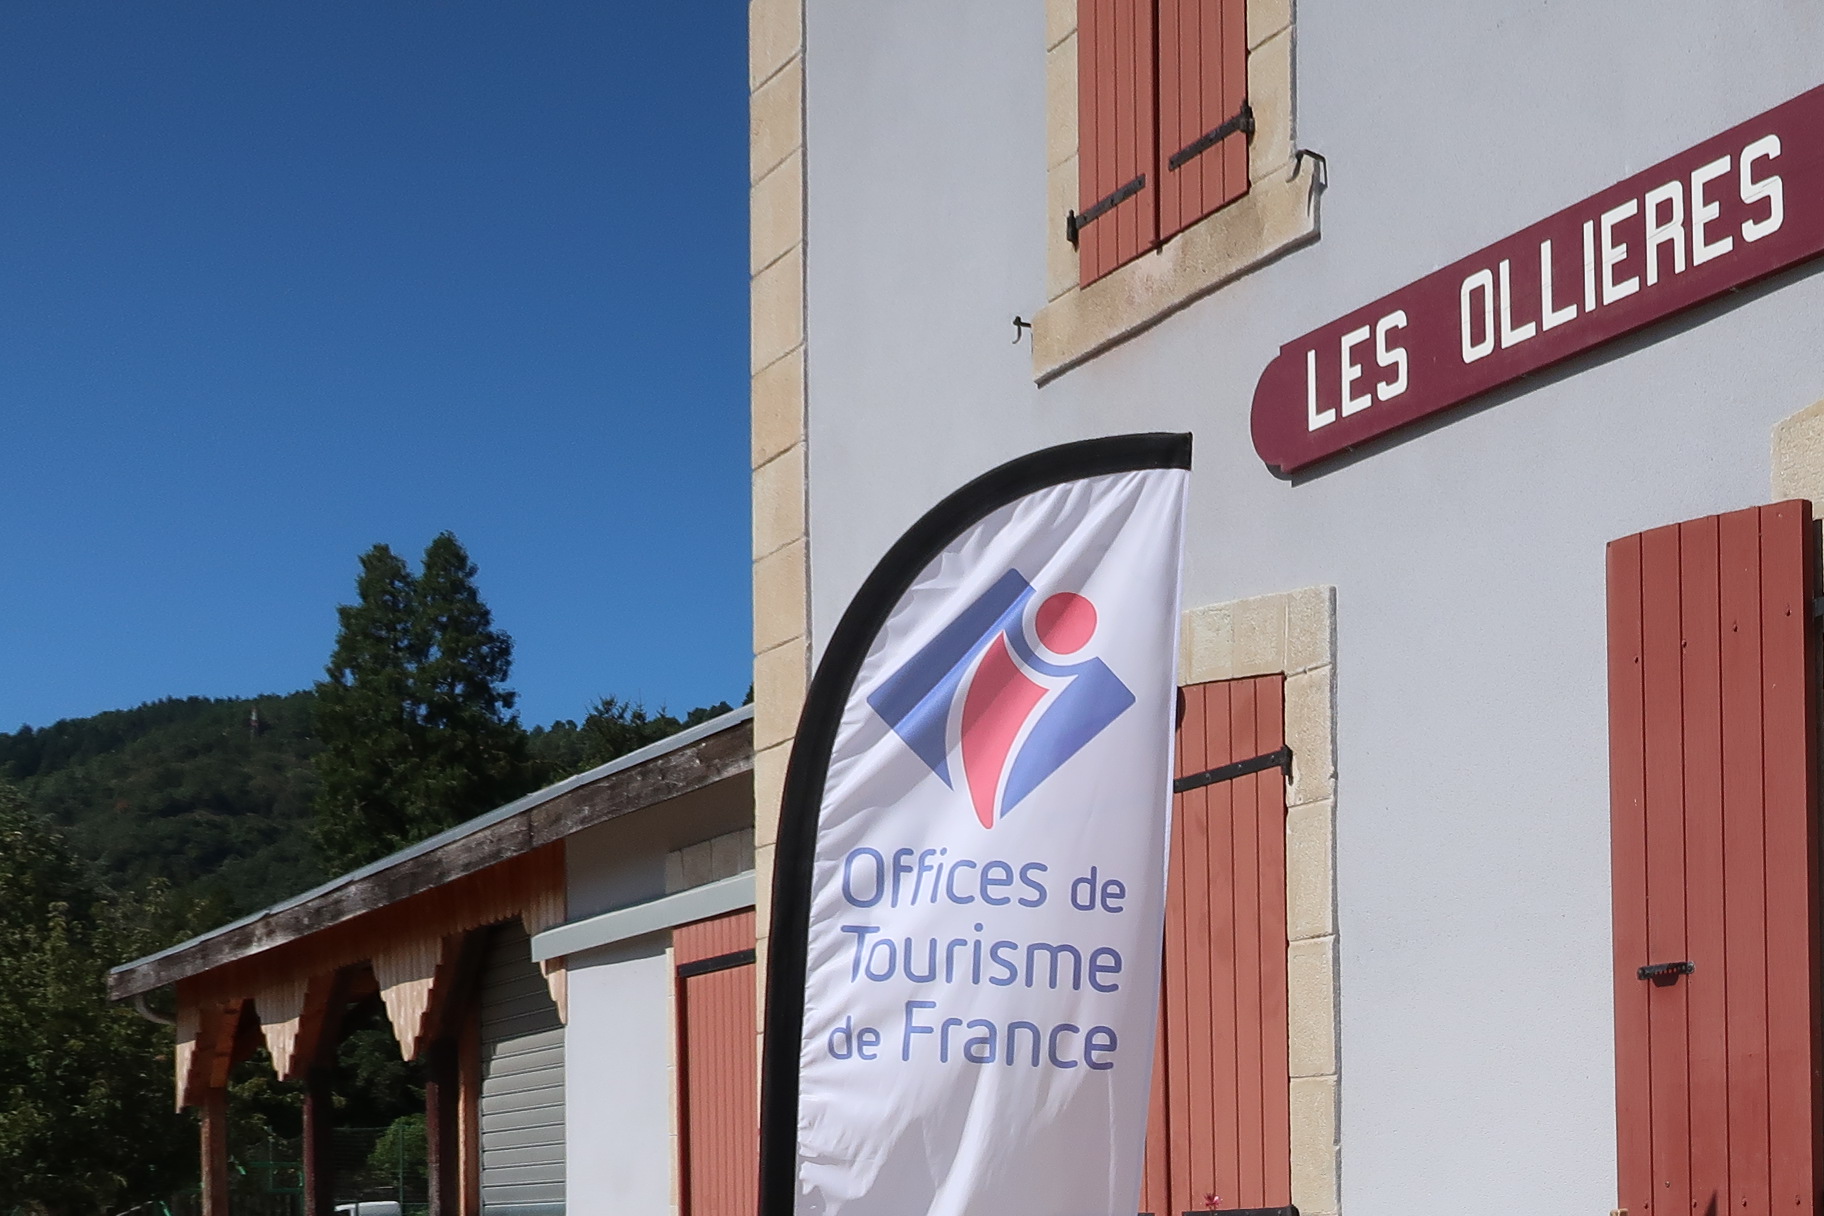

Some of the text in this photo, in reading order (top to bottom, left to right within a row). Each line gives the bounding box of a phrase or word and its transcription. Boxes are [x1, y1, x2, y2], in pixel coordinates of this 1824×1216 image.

[1307, 134, 1784, 432] LES OLLIERES
[841, 846, 1126, 913] Offices de
[840, 922, 1123, 993] Tourisme
[827, 1000, 1117, 1071] de France
